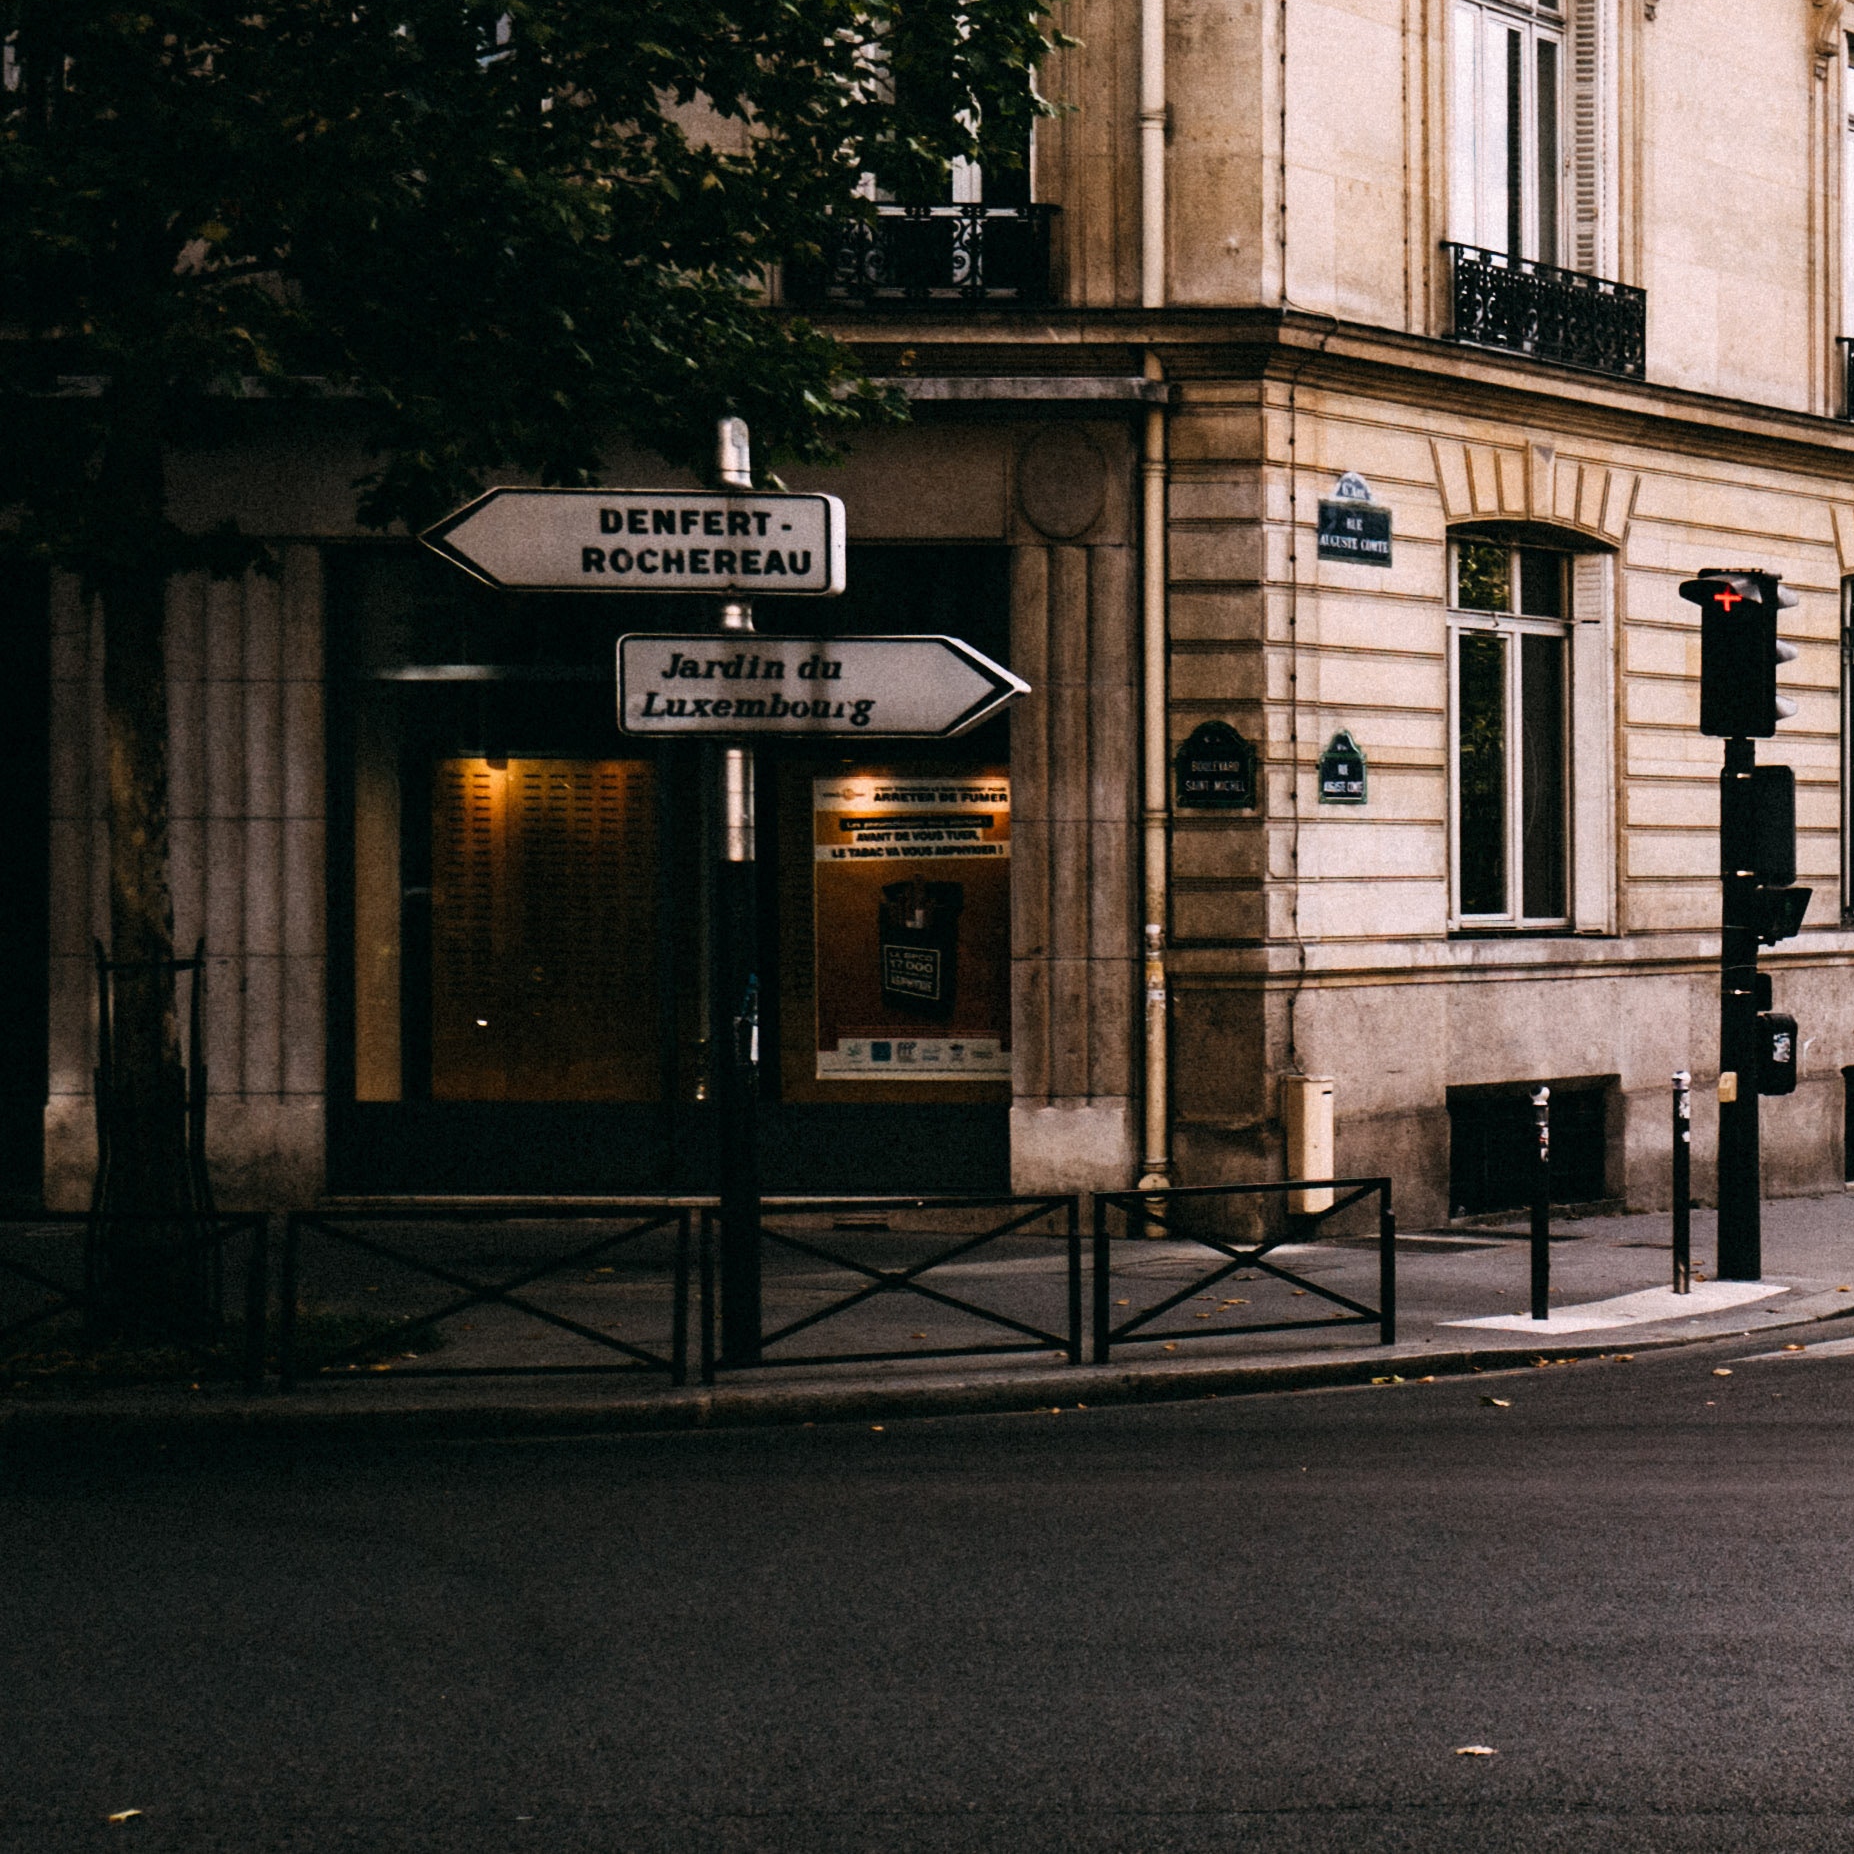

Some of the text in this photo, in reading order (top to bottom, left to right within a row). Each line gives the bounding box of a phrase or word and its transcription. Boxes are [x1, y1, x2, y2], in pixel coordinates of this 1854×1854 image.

[1346, 518, 1363, 531] RUE
[1320, 534, 1389, 553] AUGUSTE COMTE
[582, 547, 811, 575] ROCHEREAU
[661, 653, 842, 680] Jardin du
[640, 692, 875, 726] Luxembourg
[1191, 760, 1240, 773] BOULEVARD
[1185, 780, 1246, 793] SAINT MICHEL
[961, 793, 1008, 802] FUMER
[857, 832, 892, 842] AVANT
[895, 832, 910, 841] DE
[912, 831, 944, 841] VOUS
[832, 848, 846, 858] LE
[849, 847, 884, 858] TABAC
